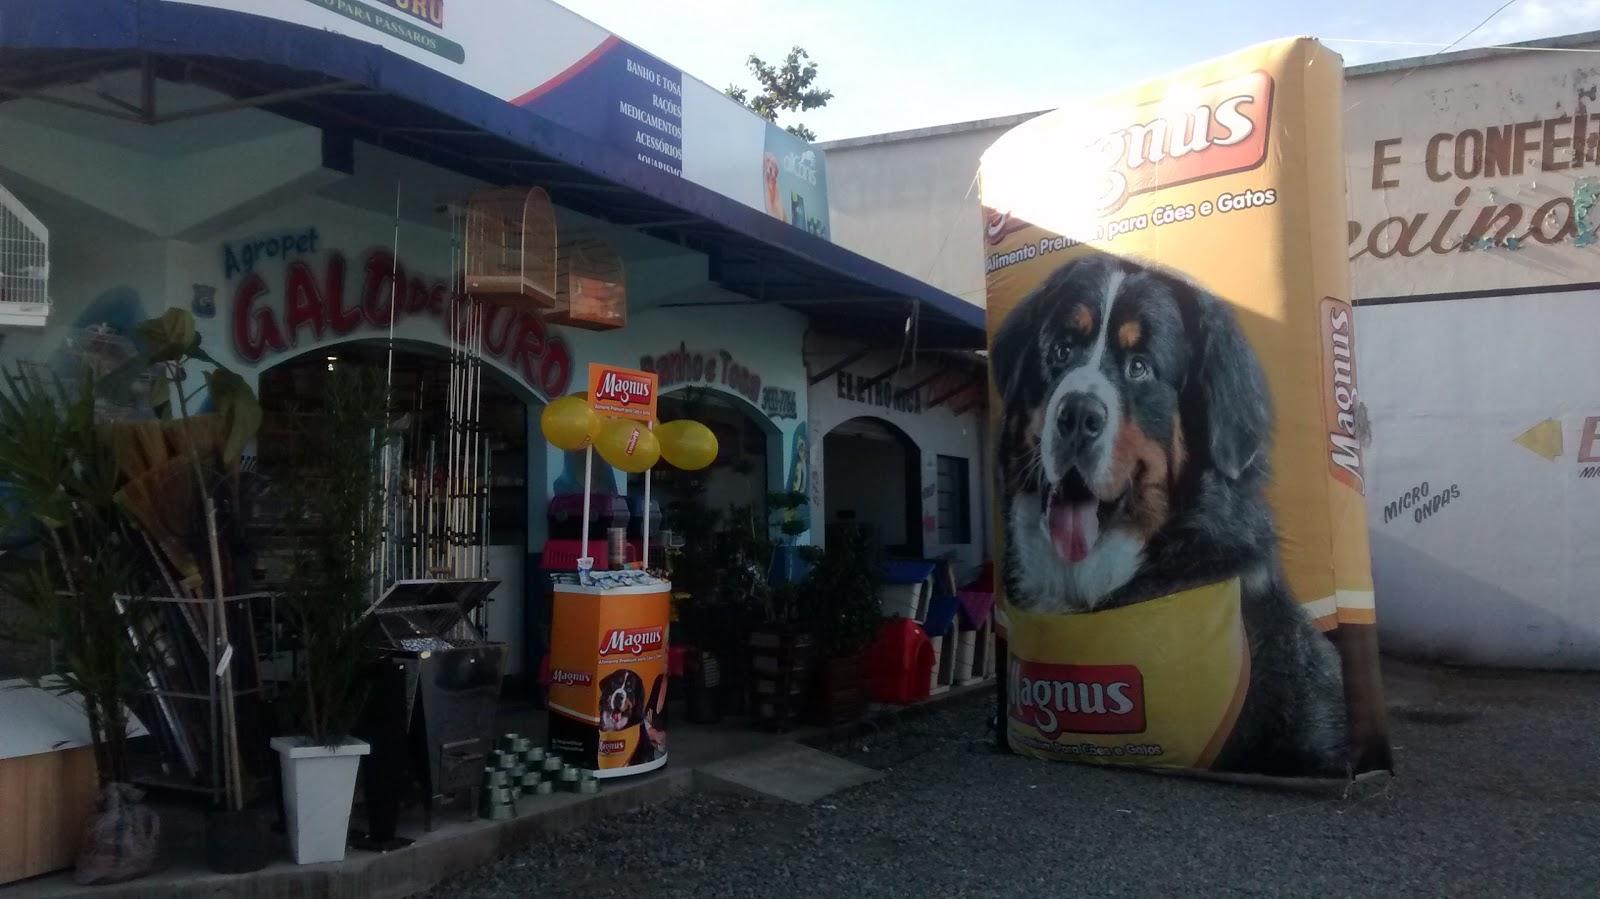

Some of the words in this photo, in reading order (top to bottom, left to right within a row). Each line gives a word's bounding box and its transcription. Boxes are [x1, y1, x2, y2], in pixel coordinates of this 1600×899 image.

[337, 1, 372, 23] PARA
[626, 58, 655, 82] BANHO
[656, 74, 661, 87] E
[663, 78, 682, 97] TOSA
[619, 101, 682, 140] MEDICAMENTOS
[635, 130, 682, 160] ACESSÓRIOS
[1372, 138, 1402, 190] E
[986, 243, 1037, 272] Alimento
[1107, 213, 1148, 241] para
[1152, 203, 1196, 226] Cães
[1198, 200, 1213, 216] e
[1216, 188, 1277, 213] Gatos
[222, 227, 319, 280] Agropet
[232, 245, 406, 364] GALO
[596, 372, 650, 403] Magnus
[1330, 306, 1366, 497] Magnus
[1384, 481, 1429, 524] MICRO
[1414, 484, 1461, 524] ONDAS
[600, 630, 661, 654] Magnus
[552, 670, 591, 686] Magnus
